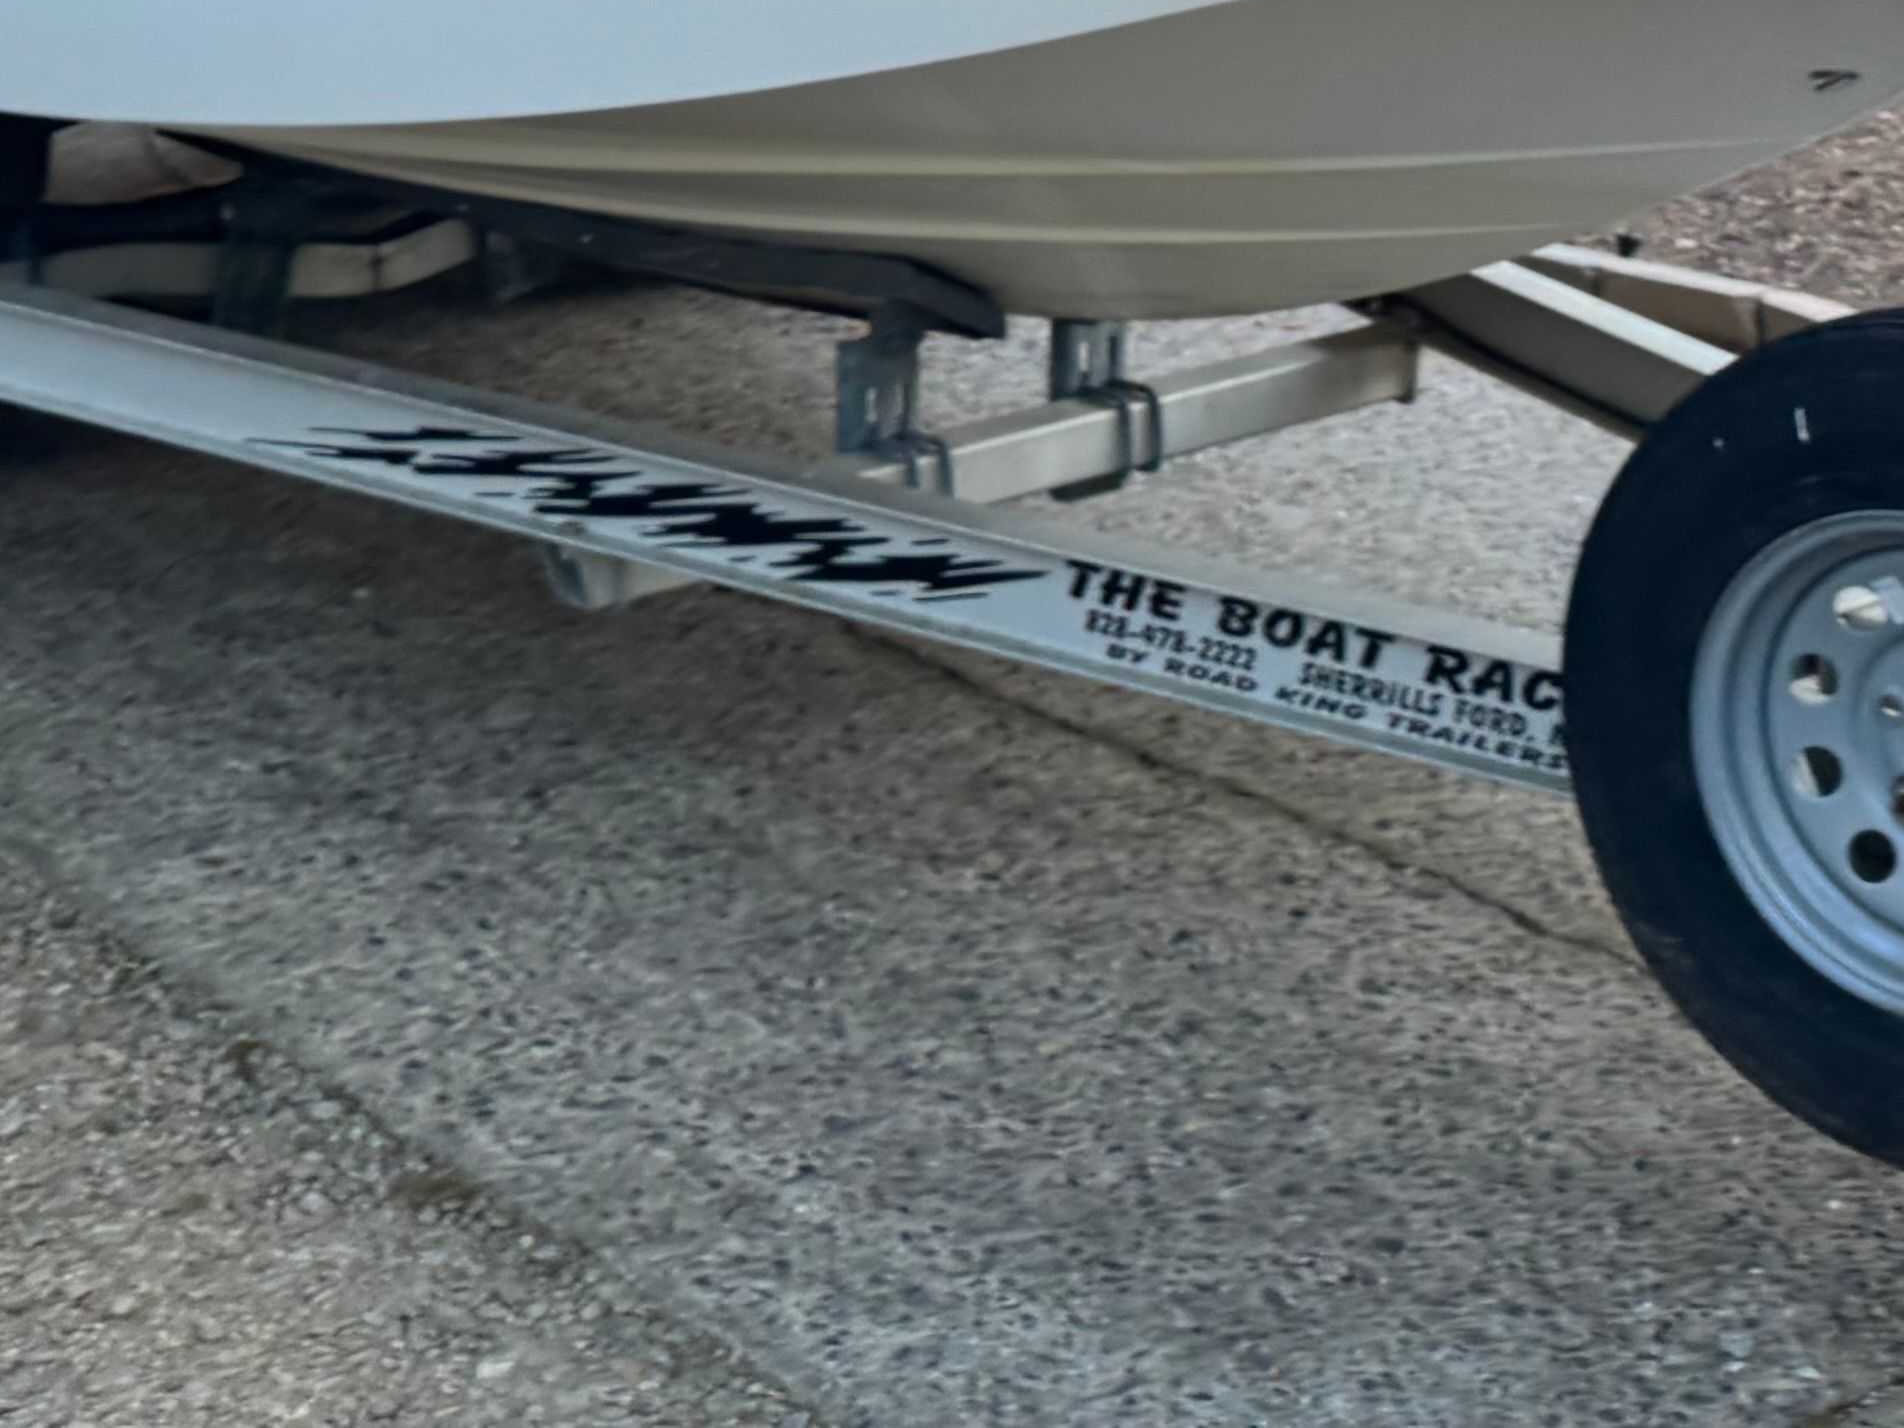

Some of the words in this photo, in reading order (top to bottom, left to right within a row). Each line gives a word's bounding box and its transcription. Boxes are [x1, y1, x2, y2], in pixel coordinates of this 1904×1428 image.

[1065, 559, 1187, 622] THE
[1217, 595, 1397, 670] BOAT
[1106, 644, 1149, 663] BY
[1163, 657, 1259, 692] ROAD
[1275, 685, 1367, 720] KING
